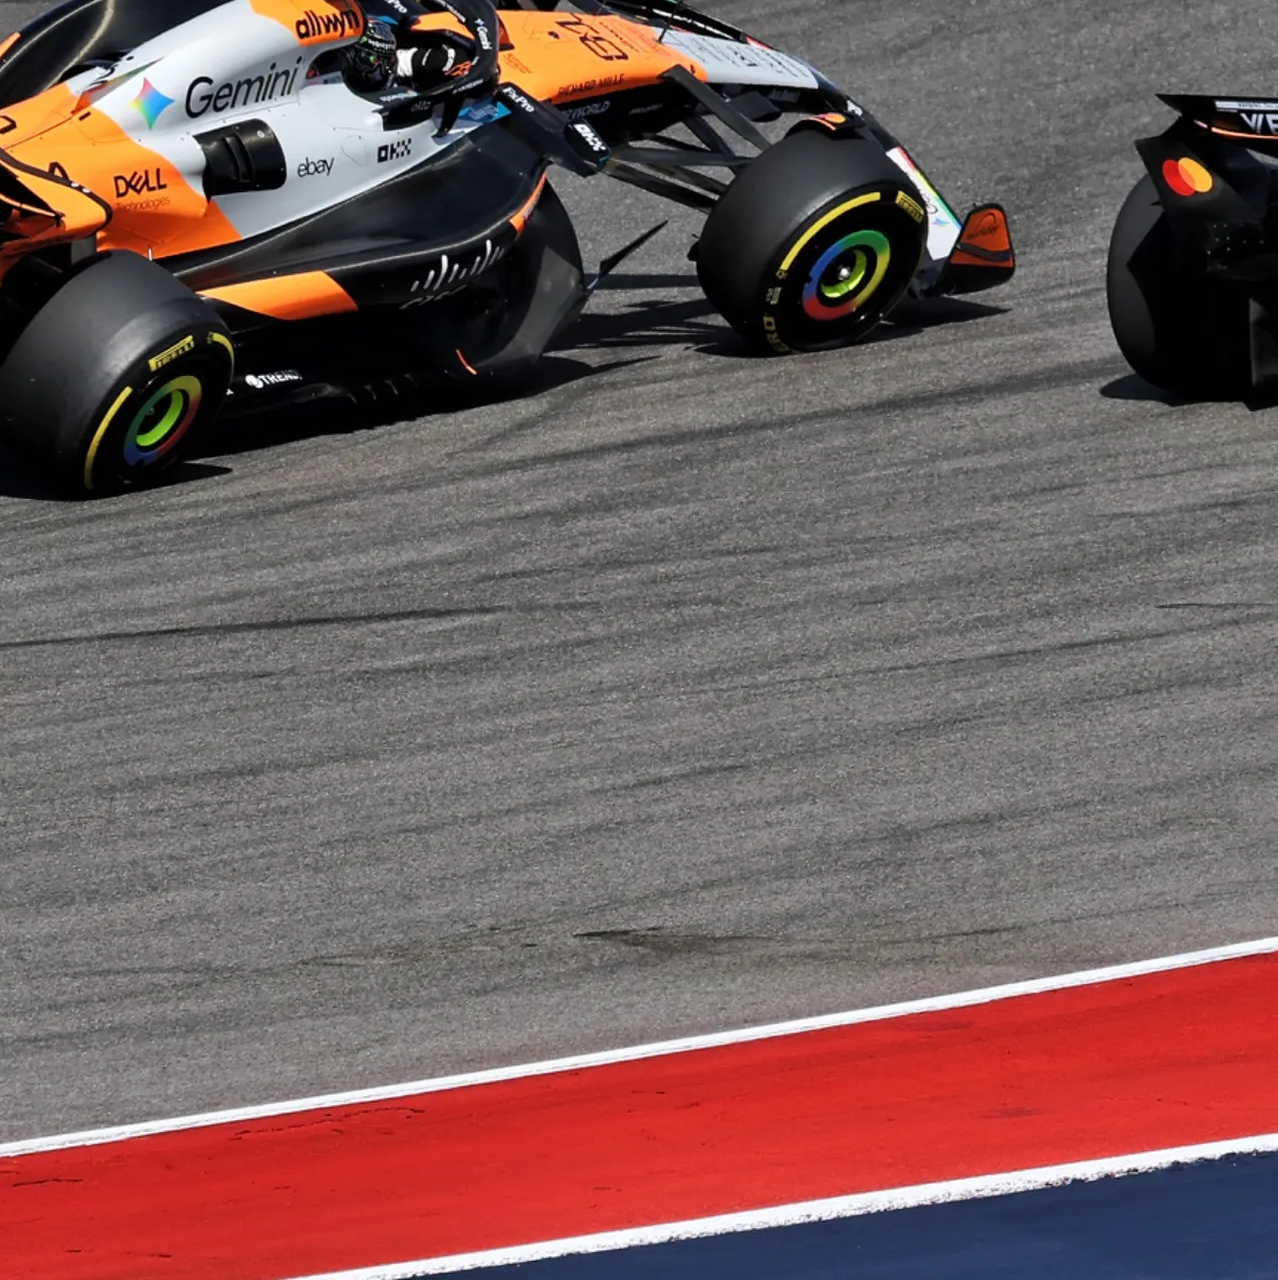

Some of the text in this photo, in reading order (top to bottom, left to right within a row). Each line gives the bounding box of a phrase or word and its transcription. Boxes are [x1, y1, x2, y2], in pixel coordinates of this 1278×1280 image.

[295, 9, 361, 41] allwyn
[185, 56, 303, 118] Gemini
[377, 138, 413, 163] OKX
[297, 157, 335, 178] ebay
[113, 168, 168, 198] DELL
